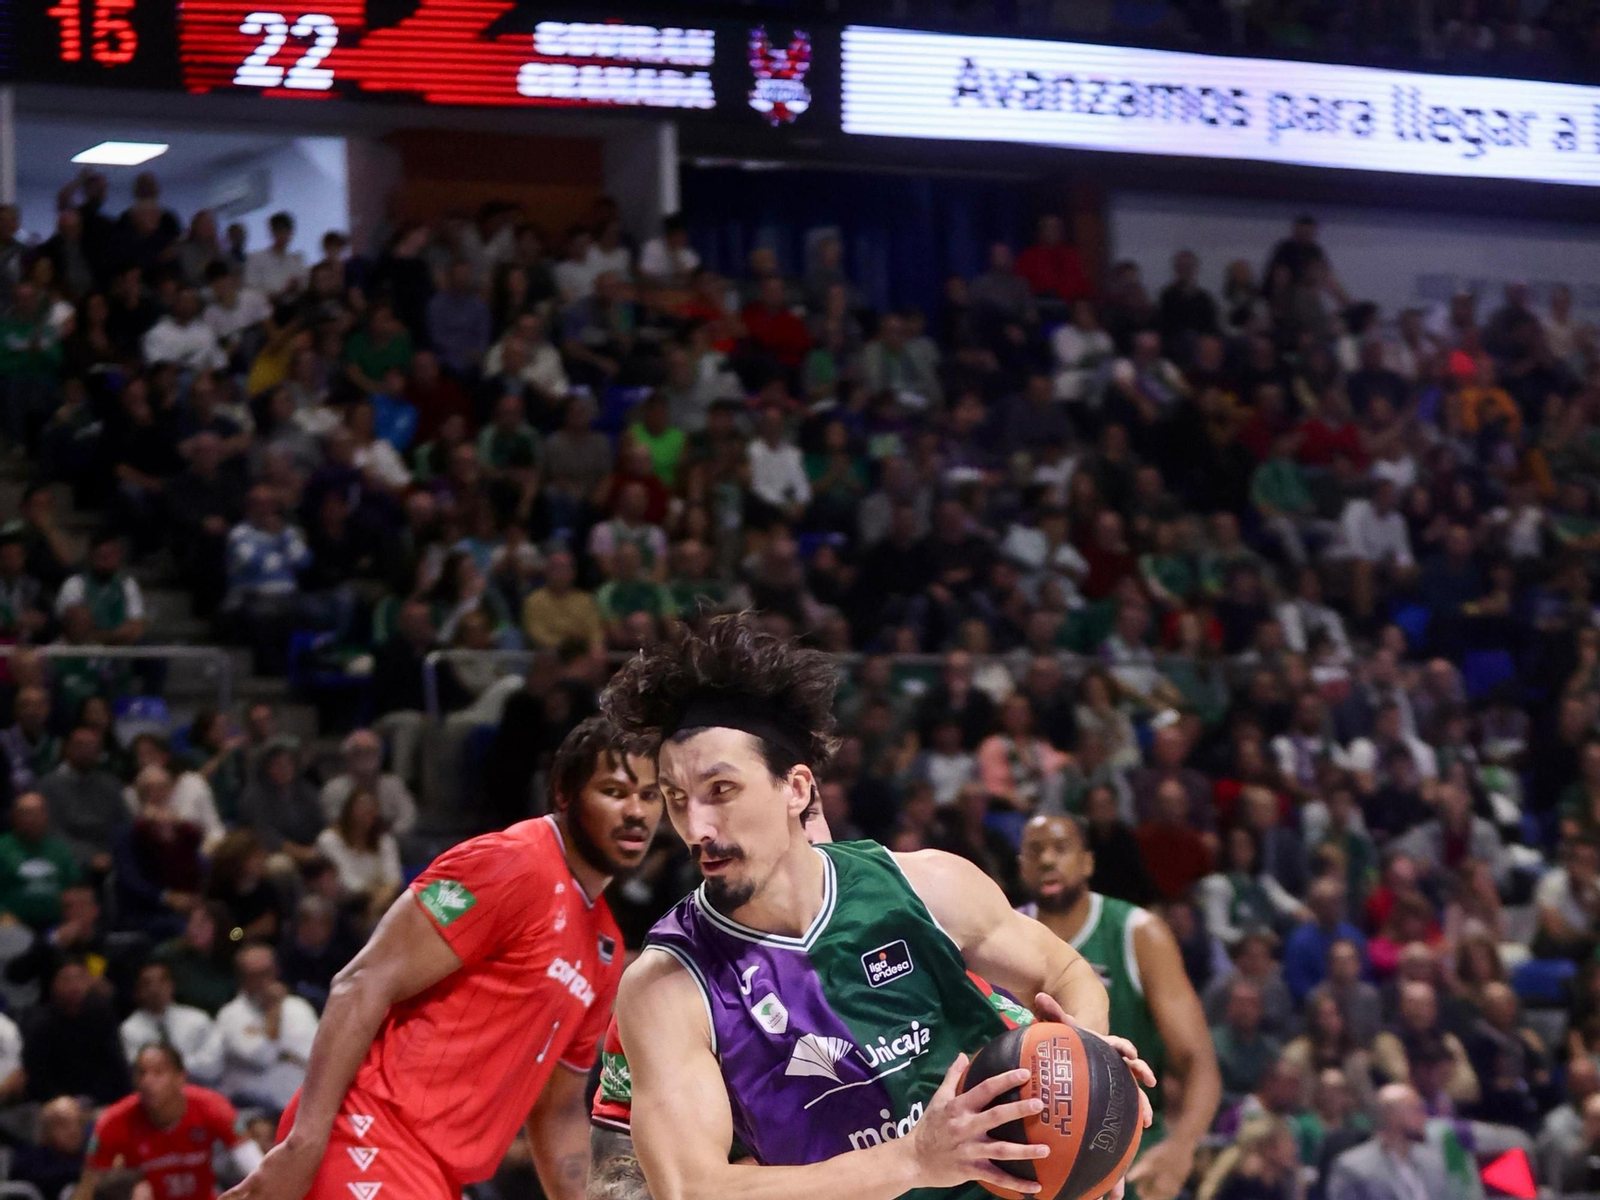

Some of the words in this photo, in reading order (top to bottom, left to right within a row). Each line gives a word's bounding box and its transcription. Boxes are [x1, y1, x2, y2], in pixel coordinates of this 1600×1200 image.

[233, 12, 338, 90] 22
[951, 56, 1251, 128] Avanzamos
[1268, 90, 1374, 145] para
[1391, 84, 1537, 158] llegar
[1554, 113, 1577, 151] a
[869, 960, 888, 973] liga
[872, 961, 909, 982] endesa
[855, 1020, 931, 1069] Unicaja
[1052, 1037, 1073, 1137] LEGACY
